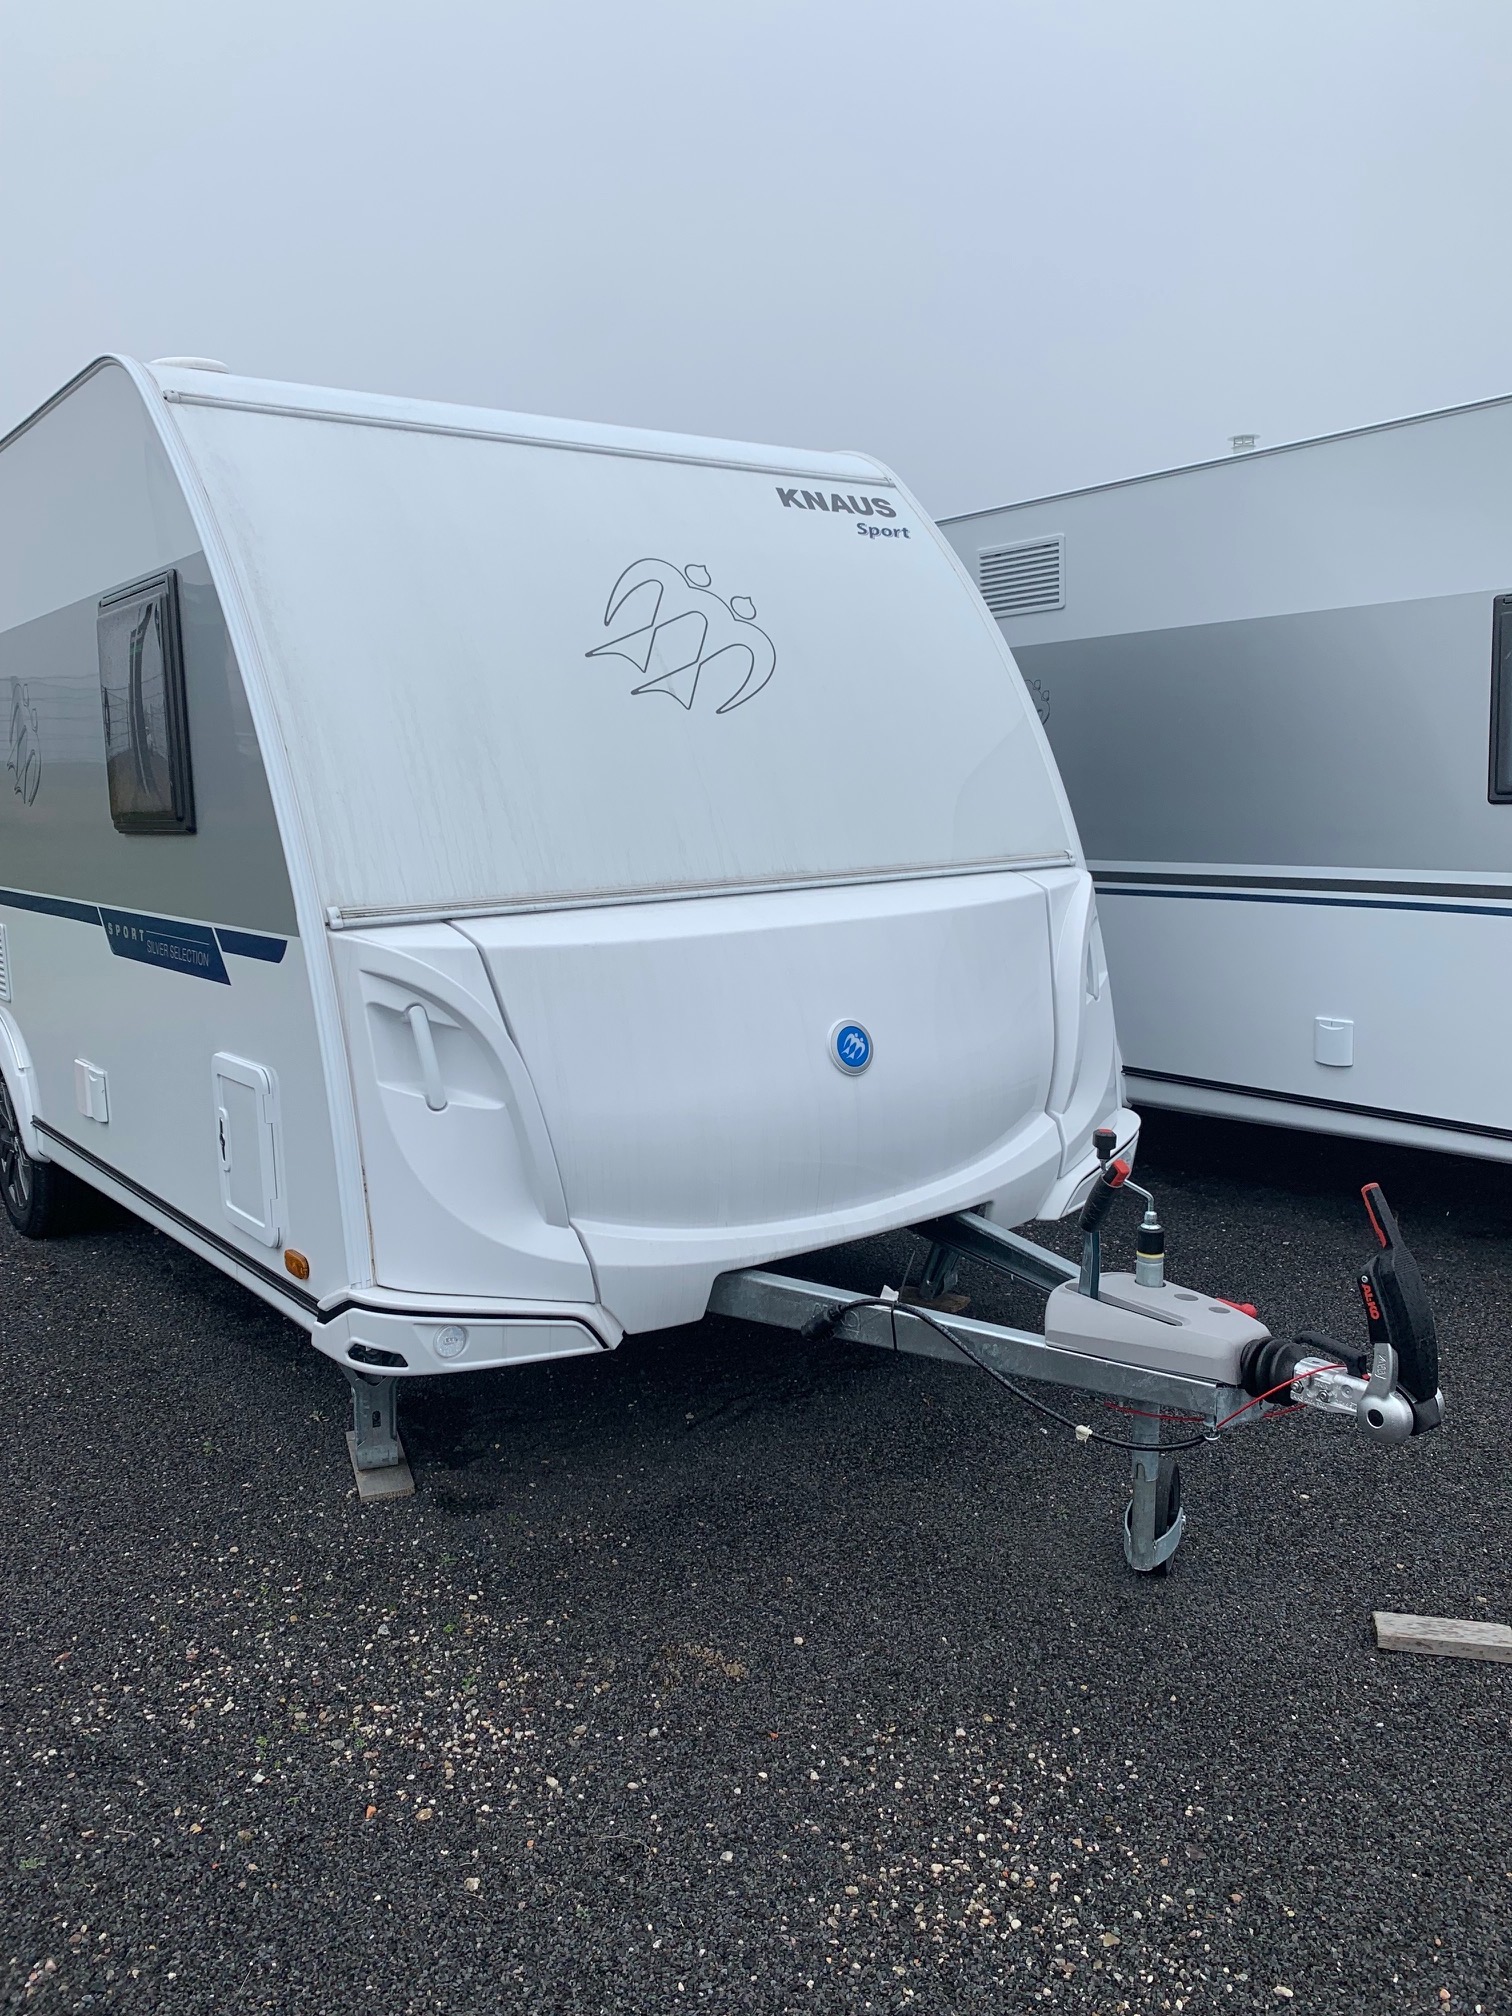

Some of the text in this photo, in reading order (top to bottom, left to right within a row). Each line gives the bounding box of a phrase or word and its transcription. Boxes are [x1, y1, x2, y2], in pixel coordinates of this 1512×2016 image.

[775, 487, 897, 518] KNAUS
[856, 522, 911, 539] Sport
[107, 922, 145, 942] SPORT
[146, 939, 210, 967] SILVER SELECTION
